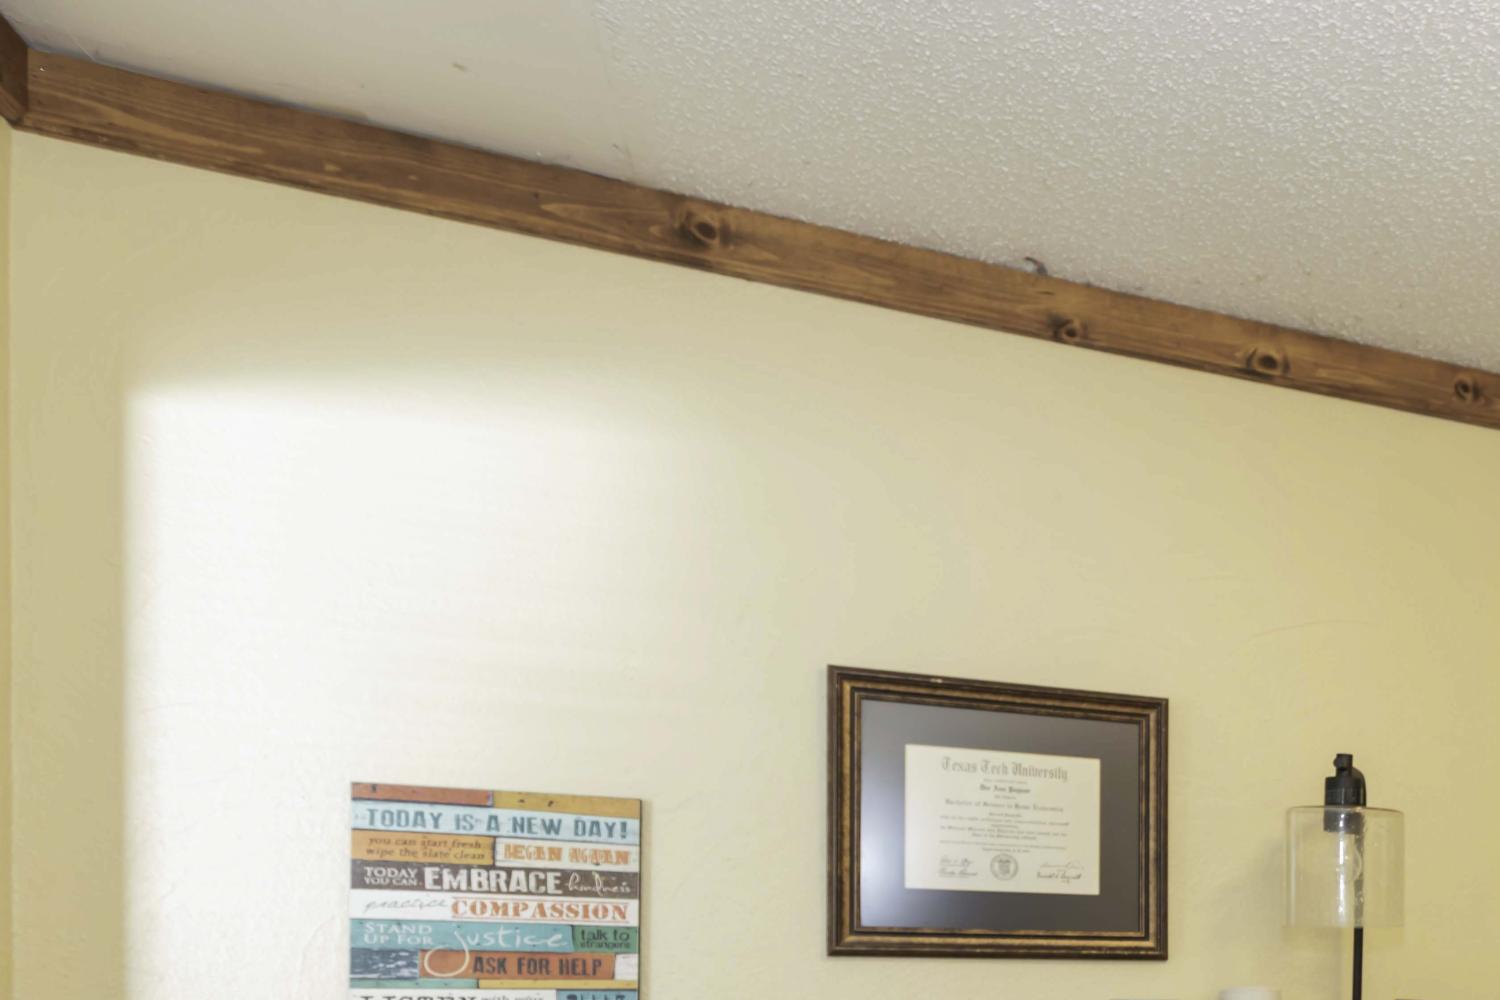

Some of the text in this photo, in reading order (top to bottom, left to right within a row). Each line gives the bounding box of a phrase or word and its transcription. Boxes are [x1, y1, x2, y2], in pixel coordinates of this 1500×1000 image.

[942, 757, 977, 774] Texas
[1012, 761, 1069, 782] University
[366, 808, 628, 839] TODAY IS A NEW DAY!
[368, 838, 391, 847] you
[395, 838, 417, 847] can
[451, 839, 482, 850] fresh
[366, 848, 394, 859] wipe
[400, 847, 419, 857] the
[453, 850, 486, 860] clean
[364, 866, 418, 878] TODAY
[364, 876, 417, 886] YOU CAN
[424, 866, 563, 895] EMBRACE
[451, 900, 630, 920] COMPASSION
[364, 921, 433, 934] STAND
[581, 929, 631, 941] talk to
[363, 925, 569, 978] UP FOR justice
[473, 955, 602, 977] ASK FOR HELP
